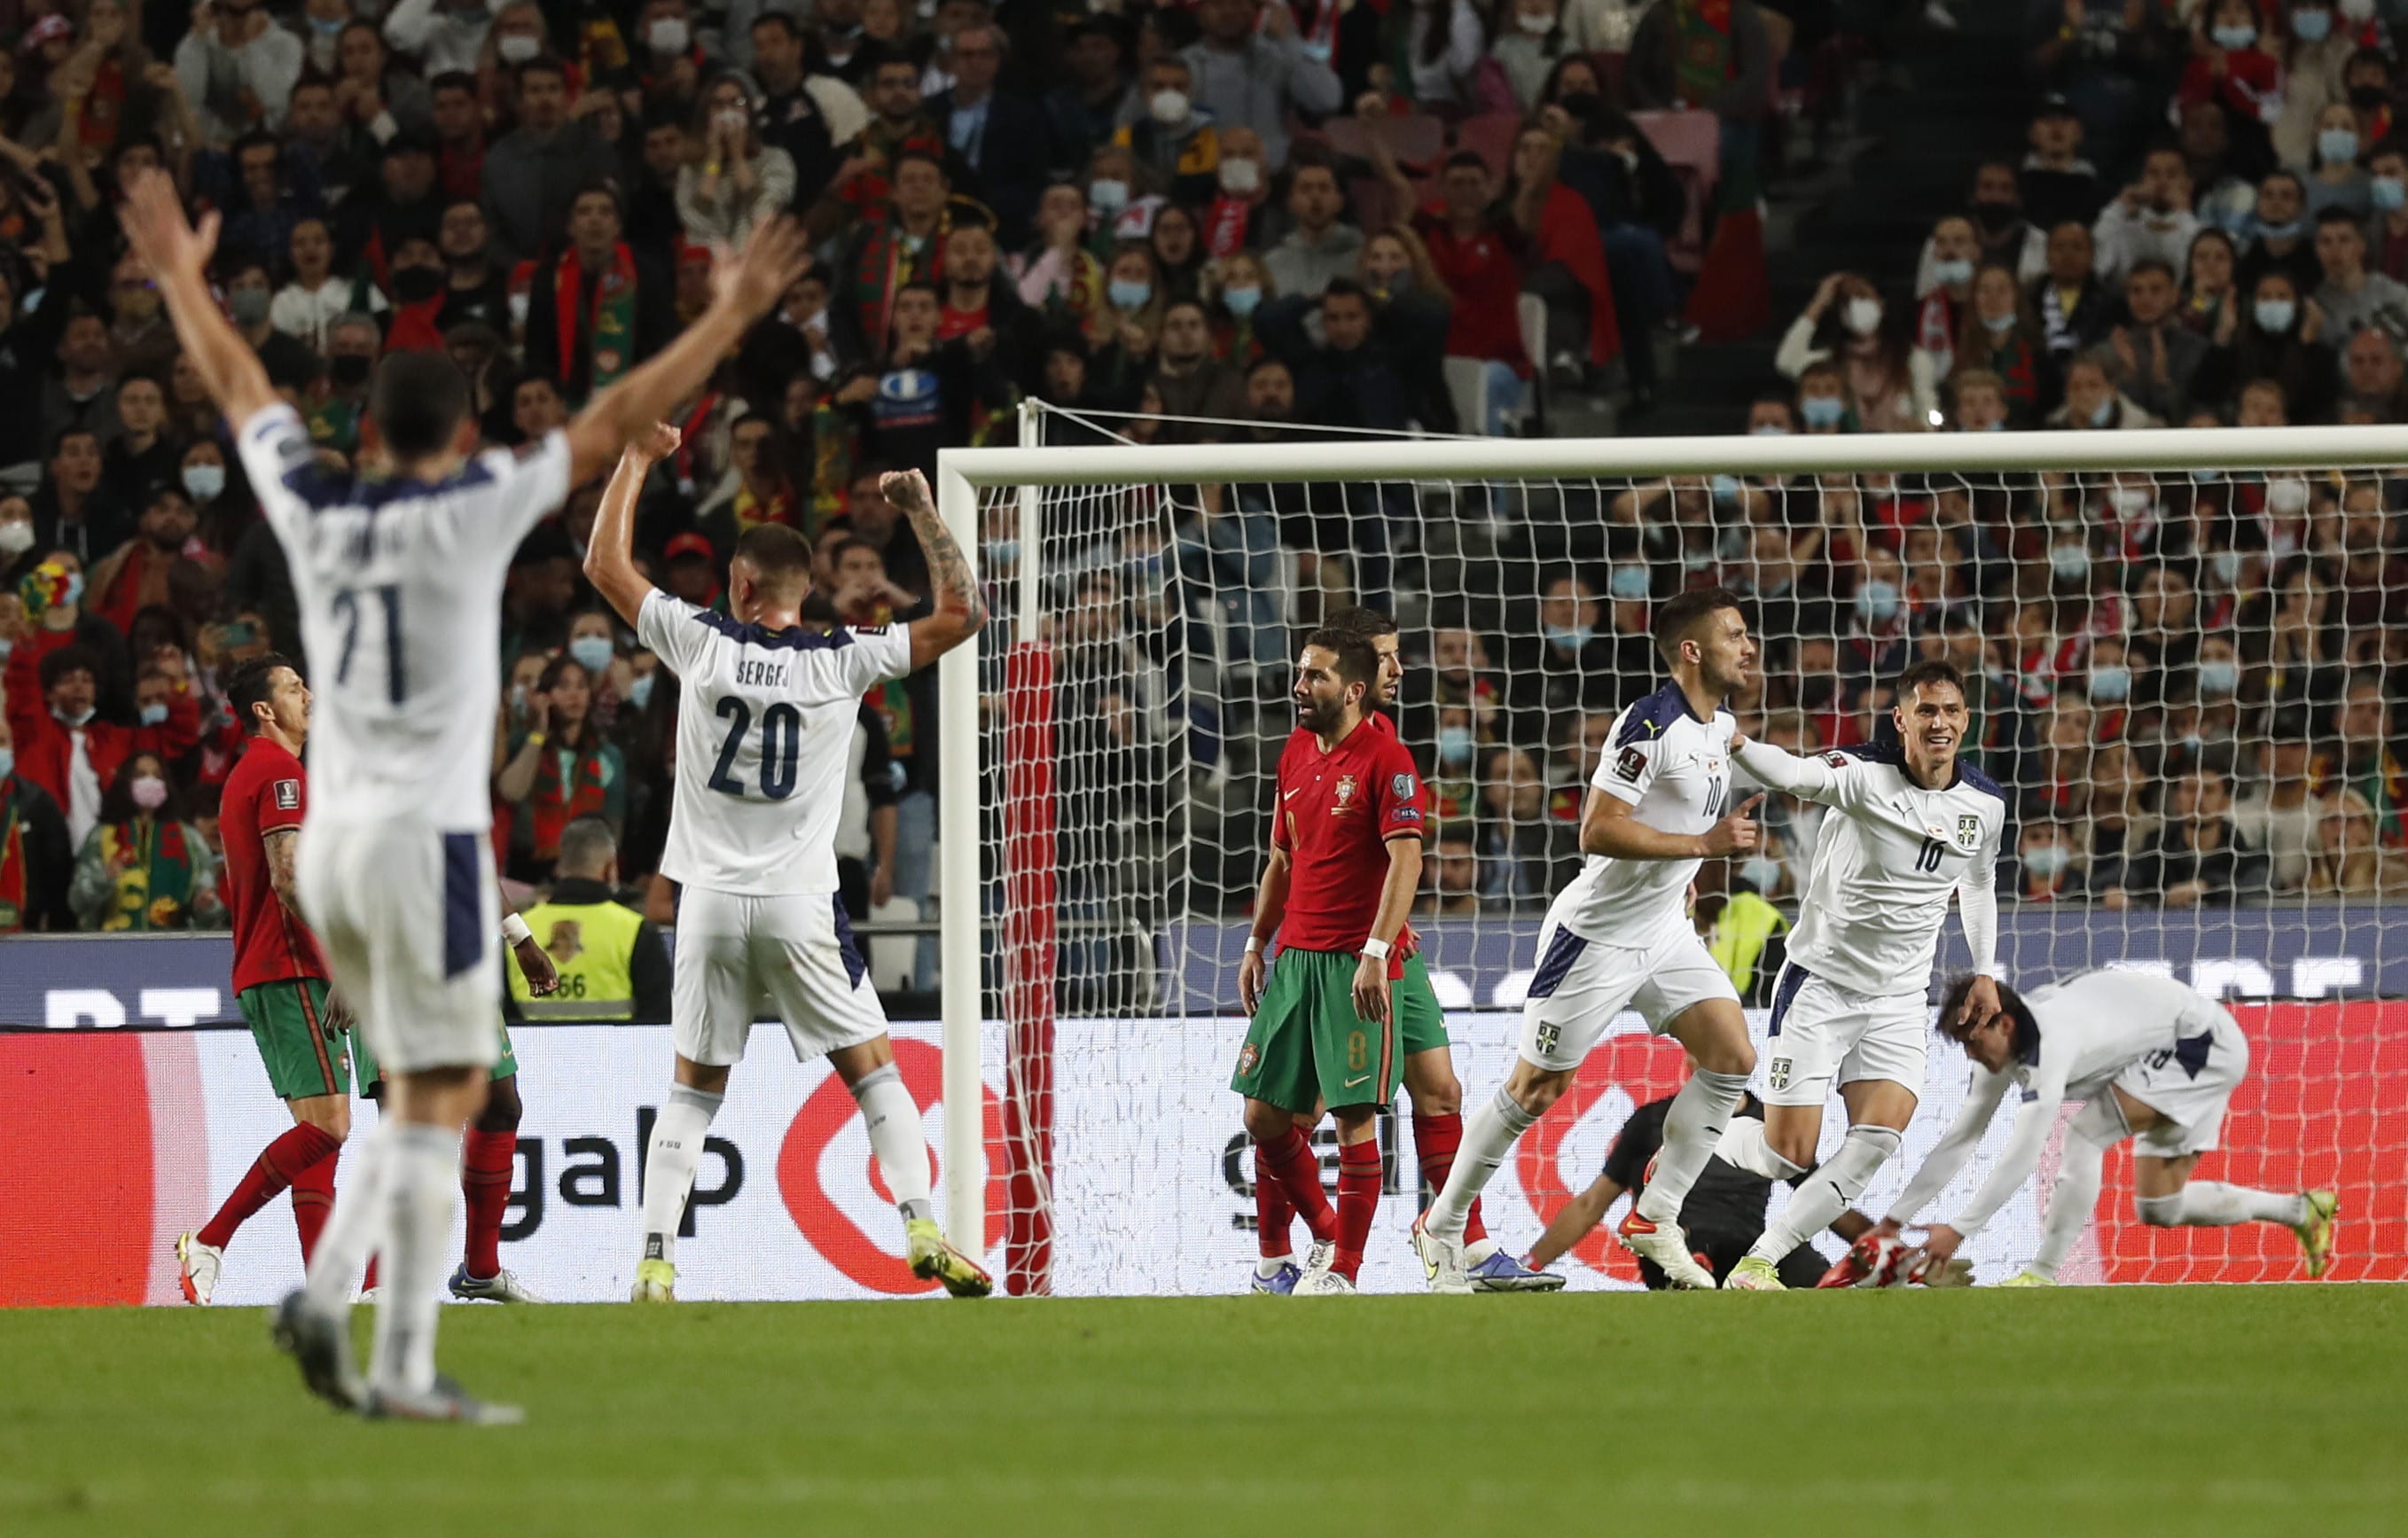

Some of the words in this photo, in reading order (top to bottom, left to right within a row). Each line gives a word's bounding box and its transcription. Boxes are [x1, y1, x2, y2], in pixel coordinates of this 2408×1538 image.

[708, 696, 801, 800] 20
[1702, 776, 1723, 817] 10
[1915, 836, 1948, 873] 16
[1348, 1030, 1366, 1072] 8
[498, 1105, 744, 1242] galp
